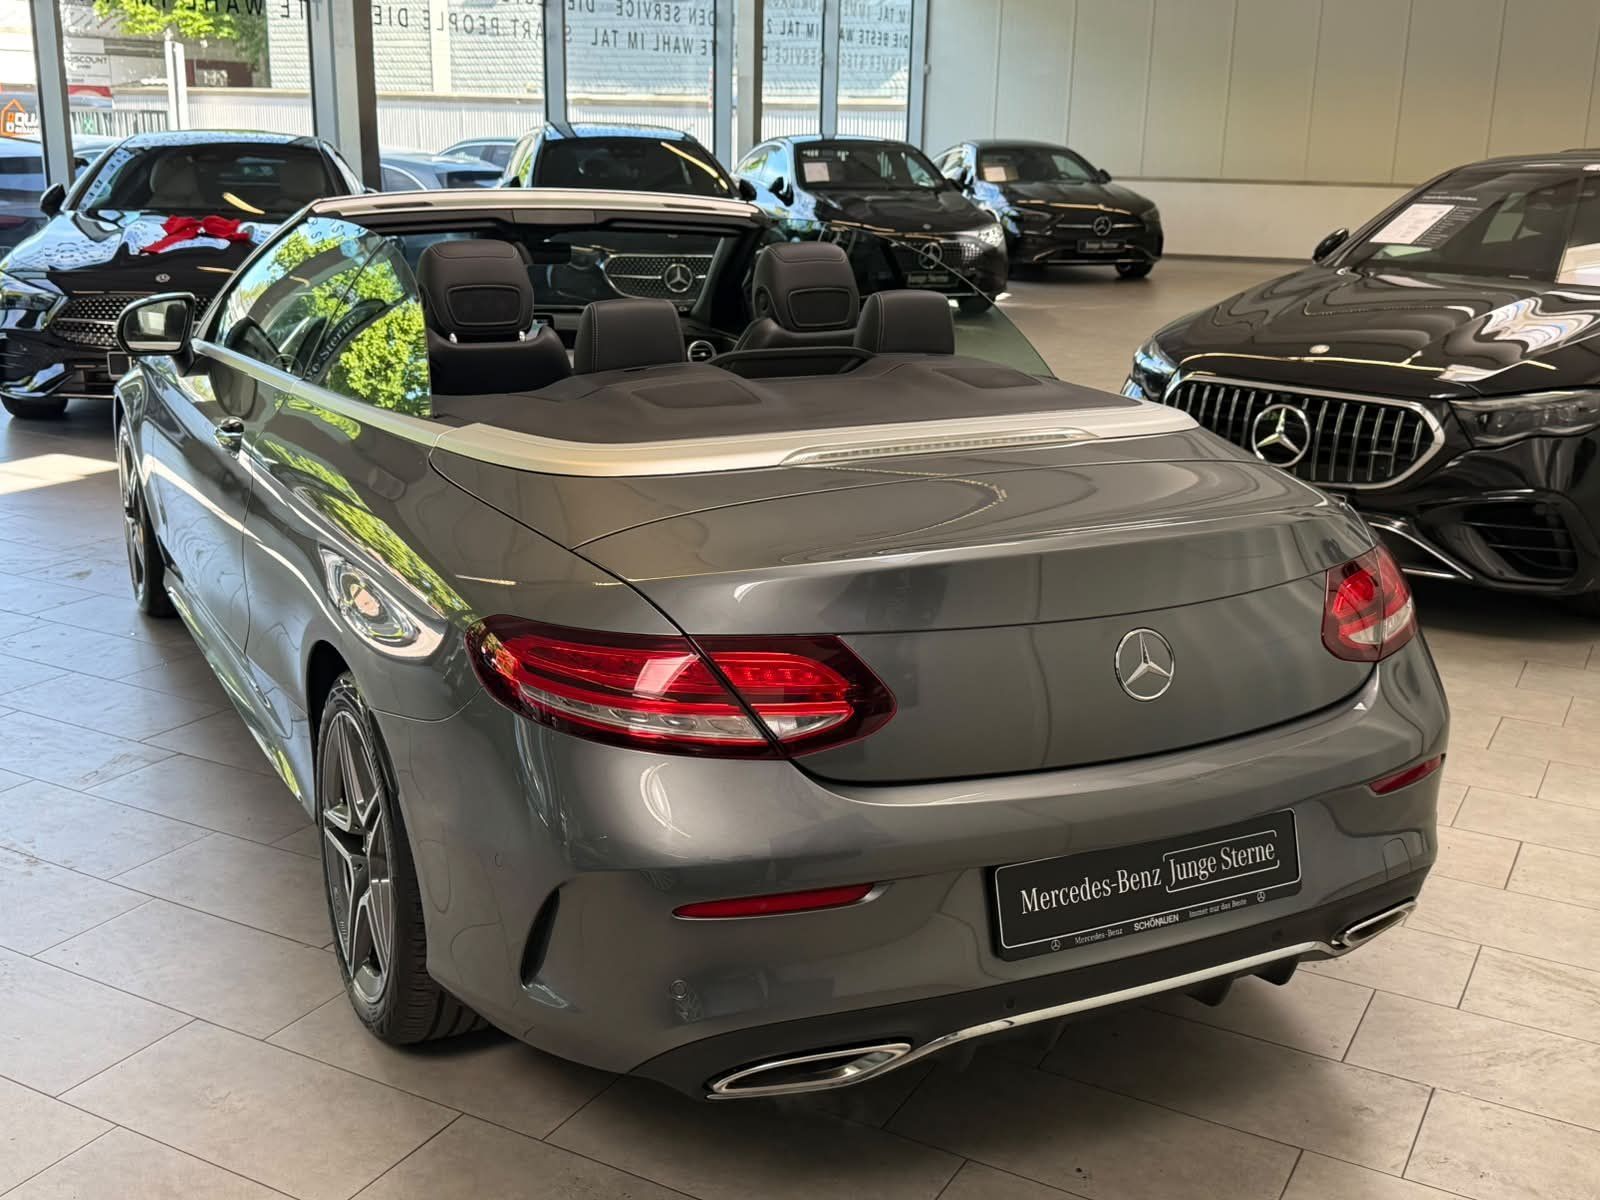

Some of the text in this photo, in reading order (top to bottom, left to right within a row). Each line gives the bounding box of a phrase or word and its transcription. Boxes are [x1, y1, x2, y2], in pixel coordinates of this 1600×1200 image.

[1020, 841, 1276, 914] Mercedes-Benz Junge Sterne
[1074, 928, 1124, 945] Mercedes-Benz
[1133, 913, 1180, 931] SCHÖNAUEN
